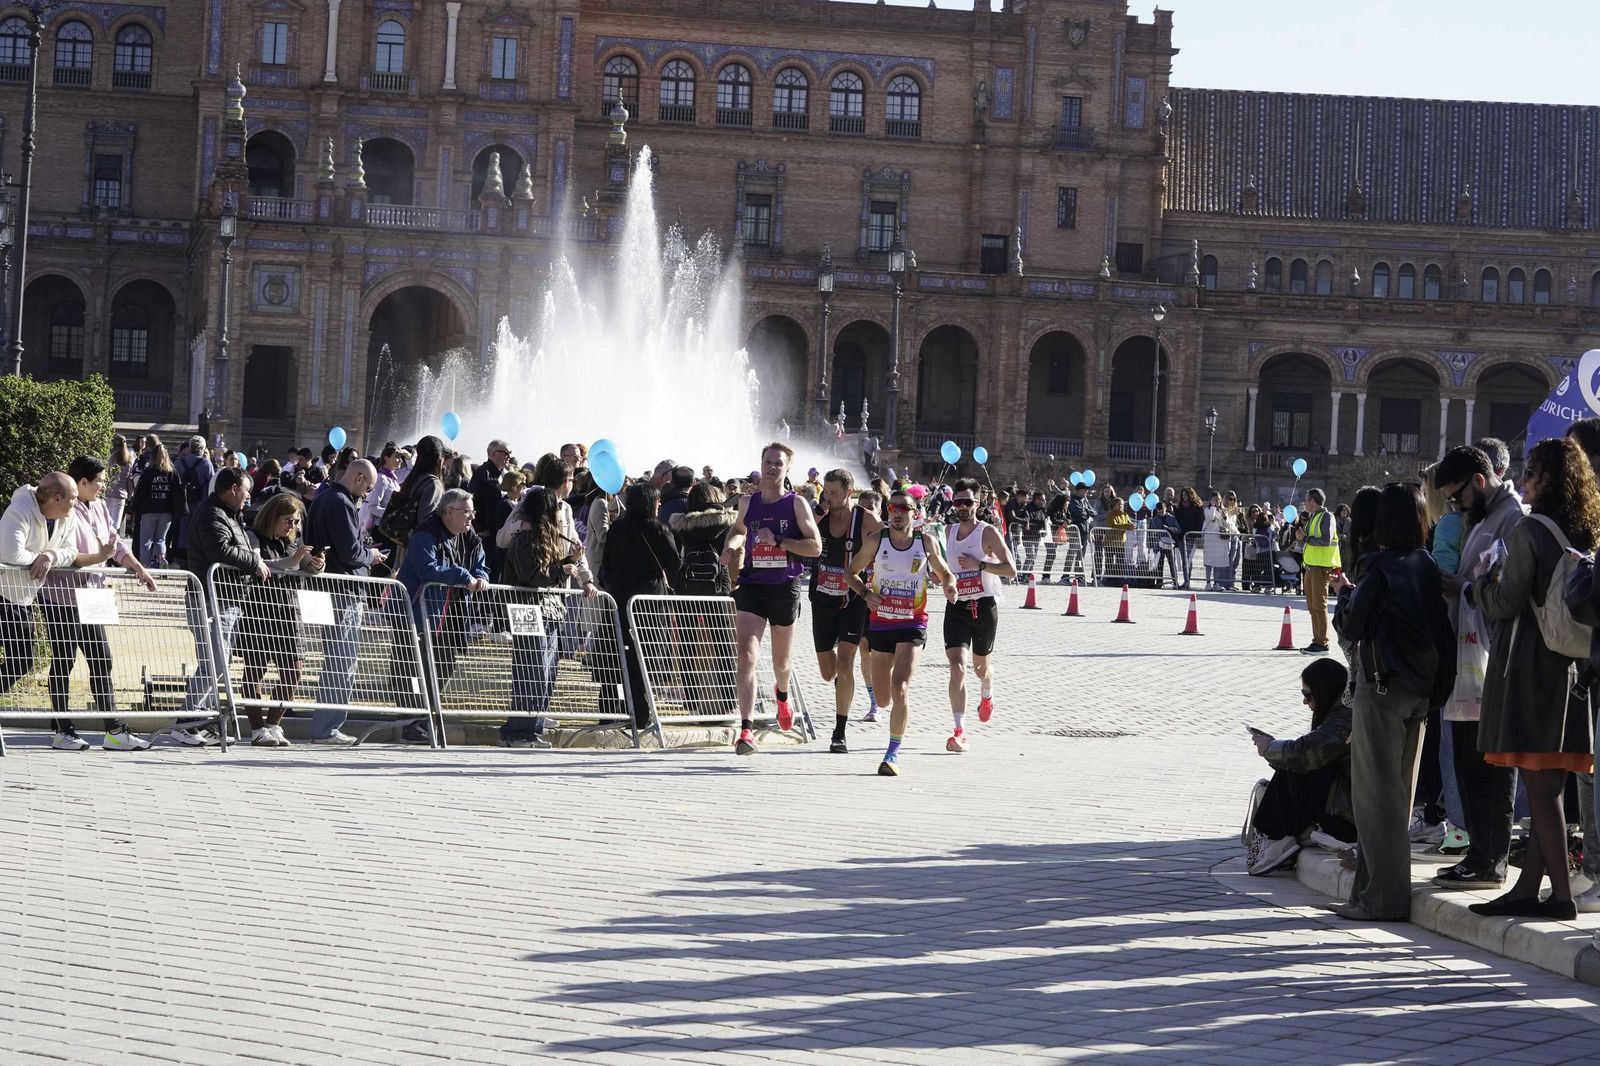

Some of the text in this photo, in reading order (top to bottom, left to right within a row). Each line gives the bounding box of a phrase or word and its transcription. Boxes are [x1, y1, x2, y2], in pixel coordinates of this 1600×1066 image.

[1539, 399, 1583, 421] ZURICH
[822, 580, 841, 588] JOSEF
[958, 585, 981, 595] JORDAN
[877, 605, 894, 613] NUNO
